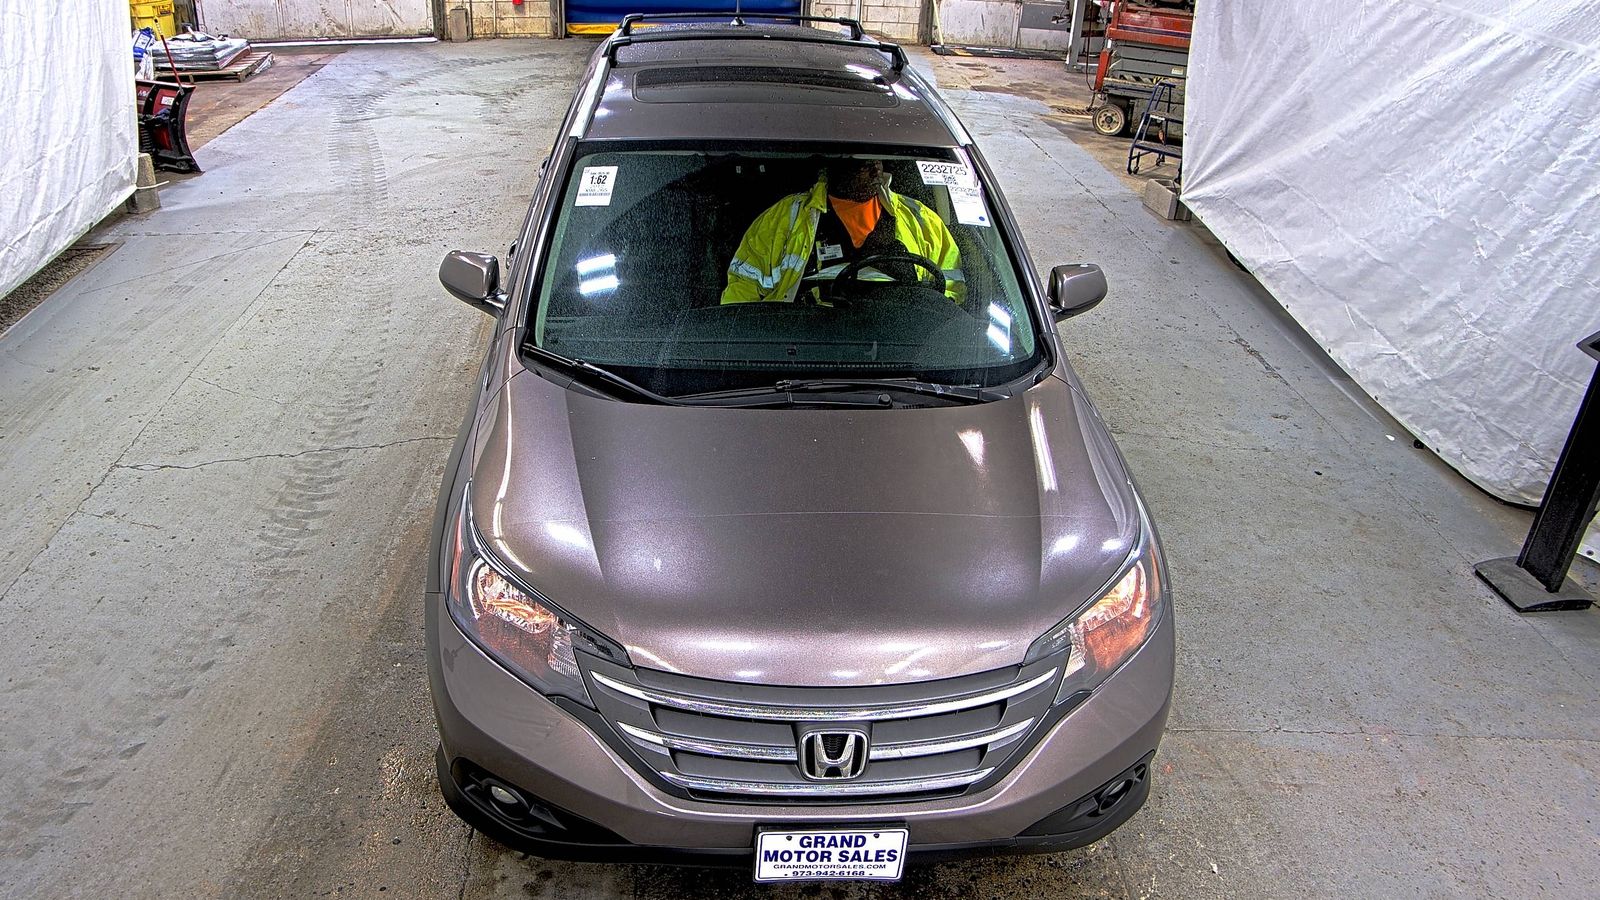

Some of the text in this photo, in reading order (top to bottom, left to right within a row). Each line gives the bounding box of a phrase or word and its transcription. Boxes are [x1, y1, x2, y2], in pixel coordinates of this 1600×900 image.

[921, 163, 967, 175] 2232725
[590, 175, 607, 184] 1:62
[799, 835, 867, 849] GRAND
[763, 849, 898, 863] MOTOR SALES
